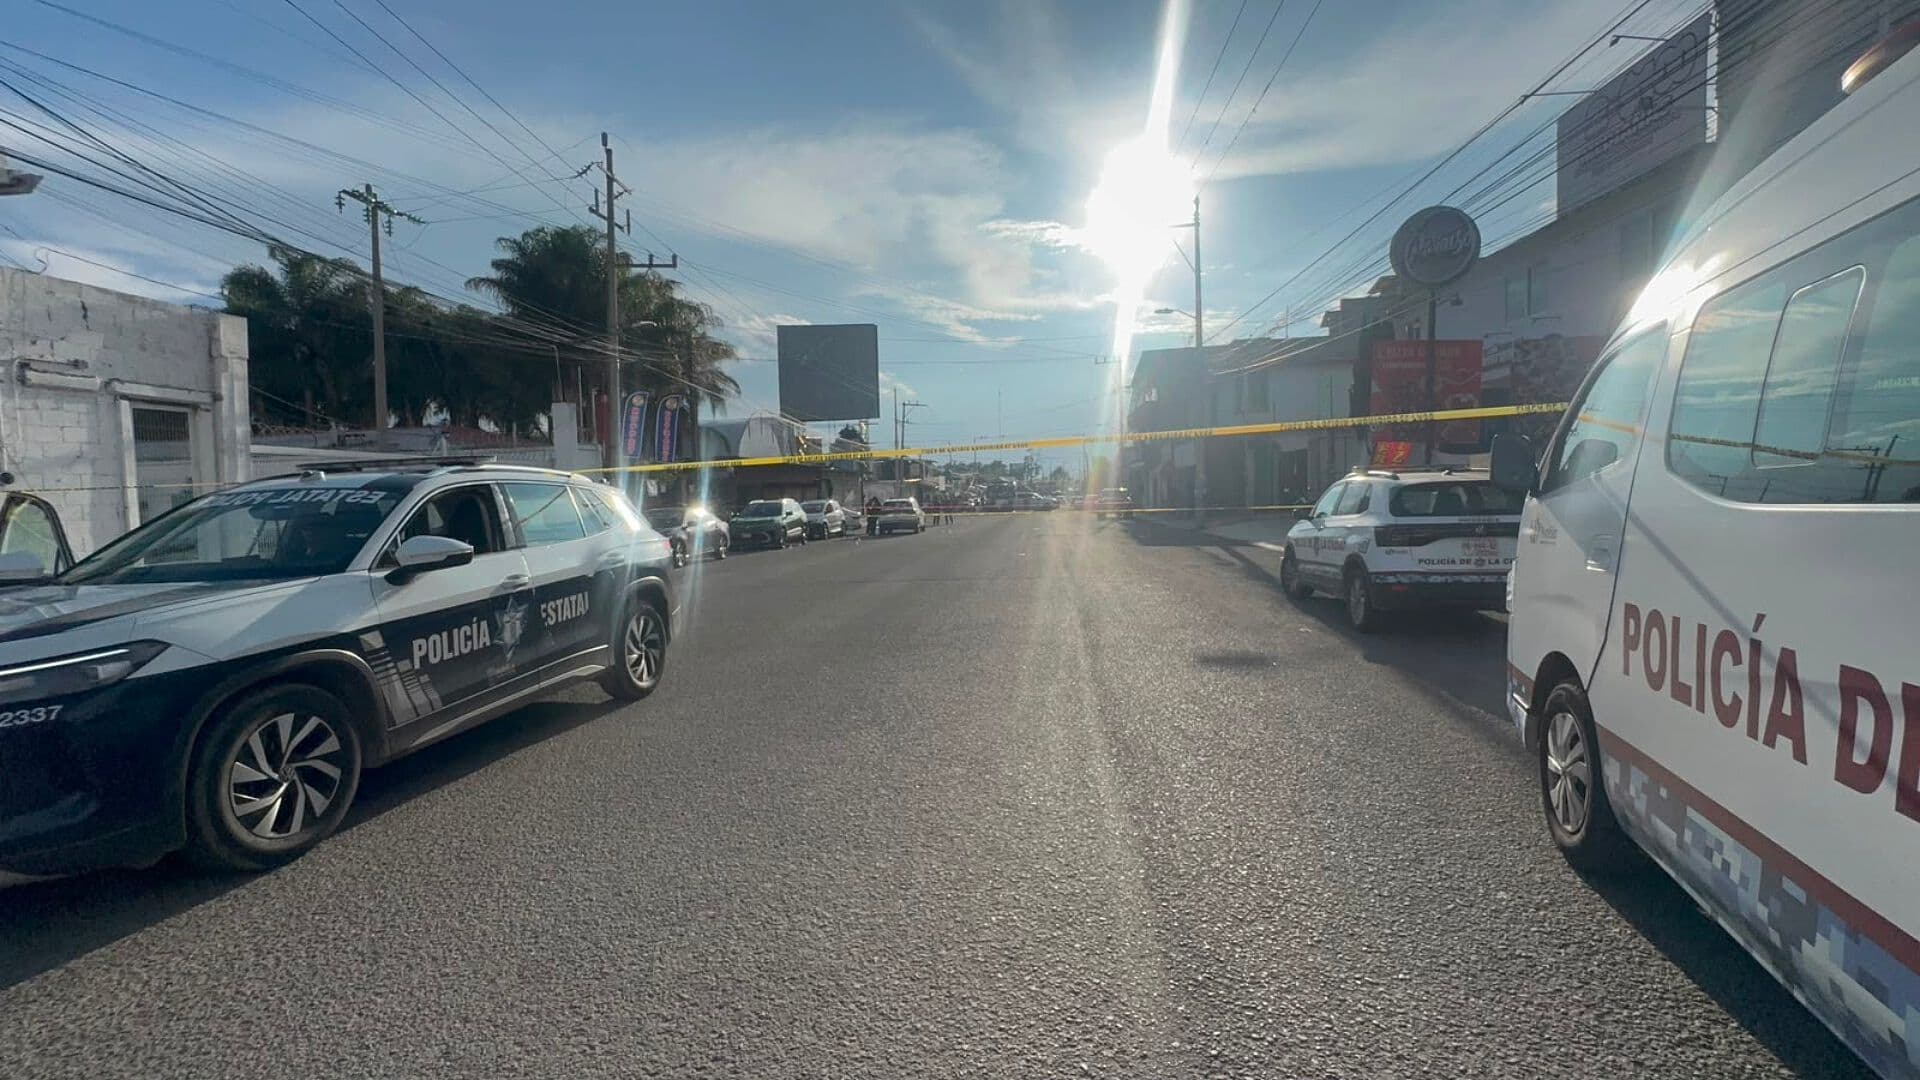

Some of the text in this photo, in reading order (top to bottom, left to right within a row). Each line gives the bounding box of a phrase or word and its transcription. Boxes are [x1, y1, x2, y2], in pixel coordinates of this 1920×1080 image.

[412, 617, 491, 670] POLICÍA
[1623, 602, 1808, 766] POLICÍA
[0, 704, 64, 727] 2337
